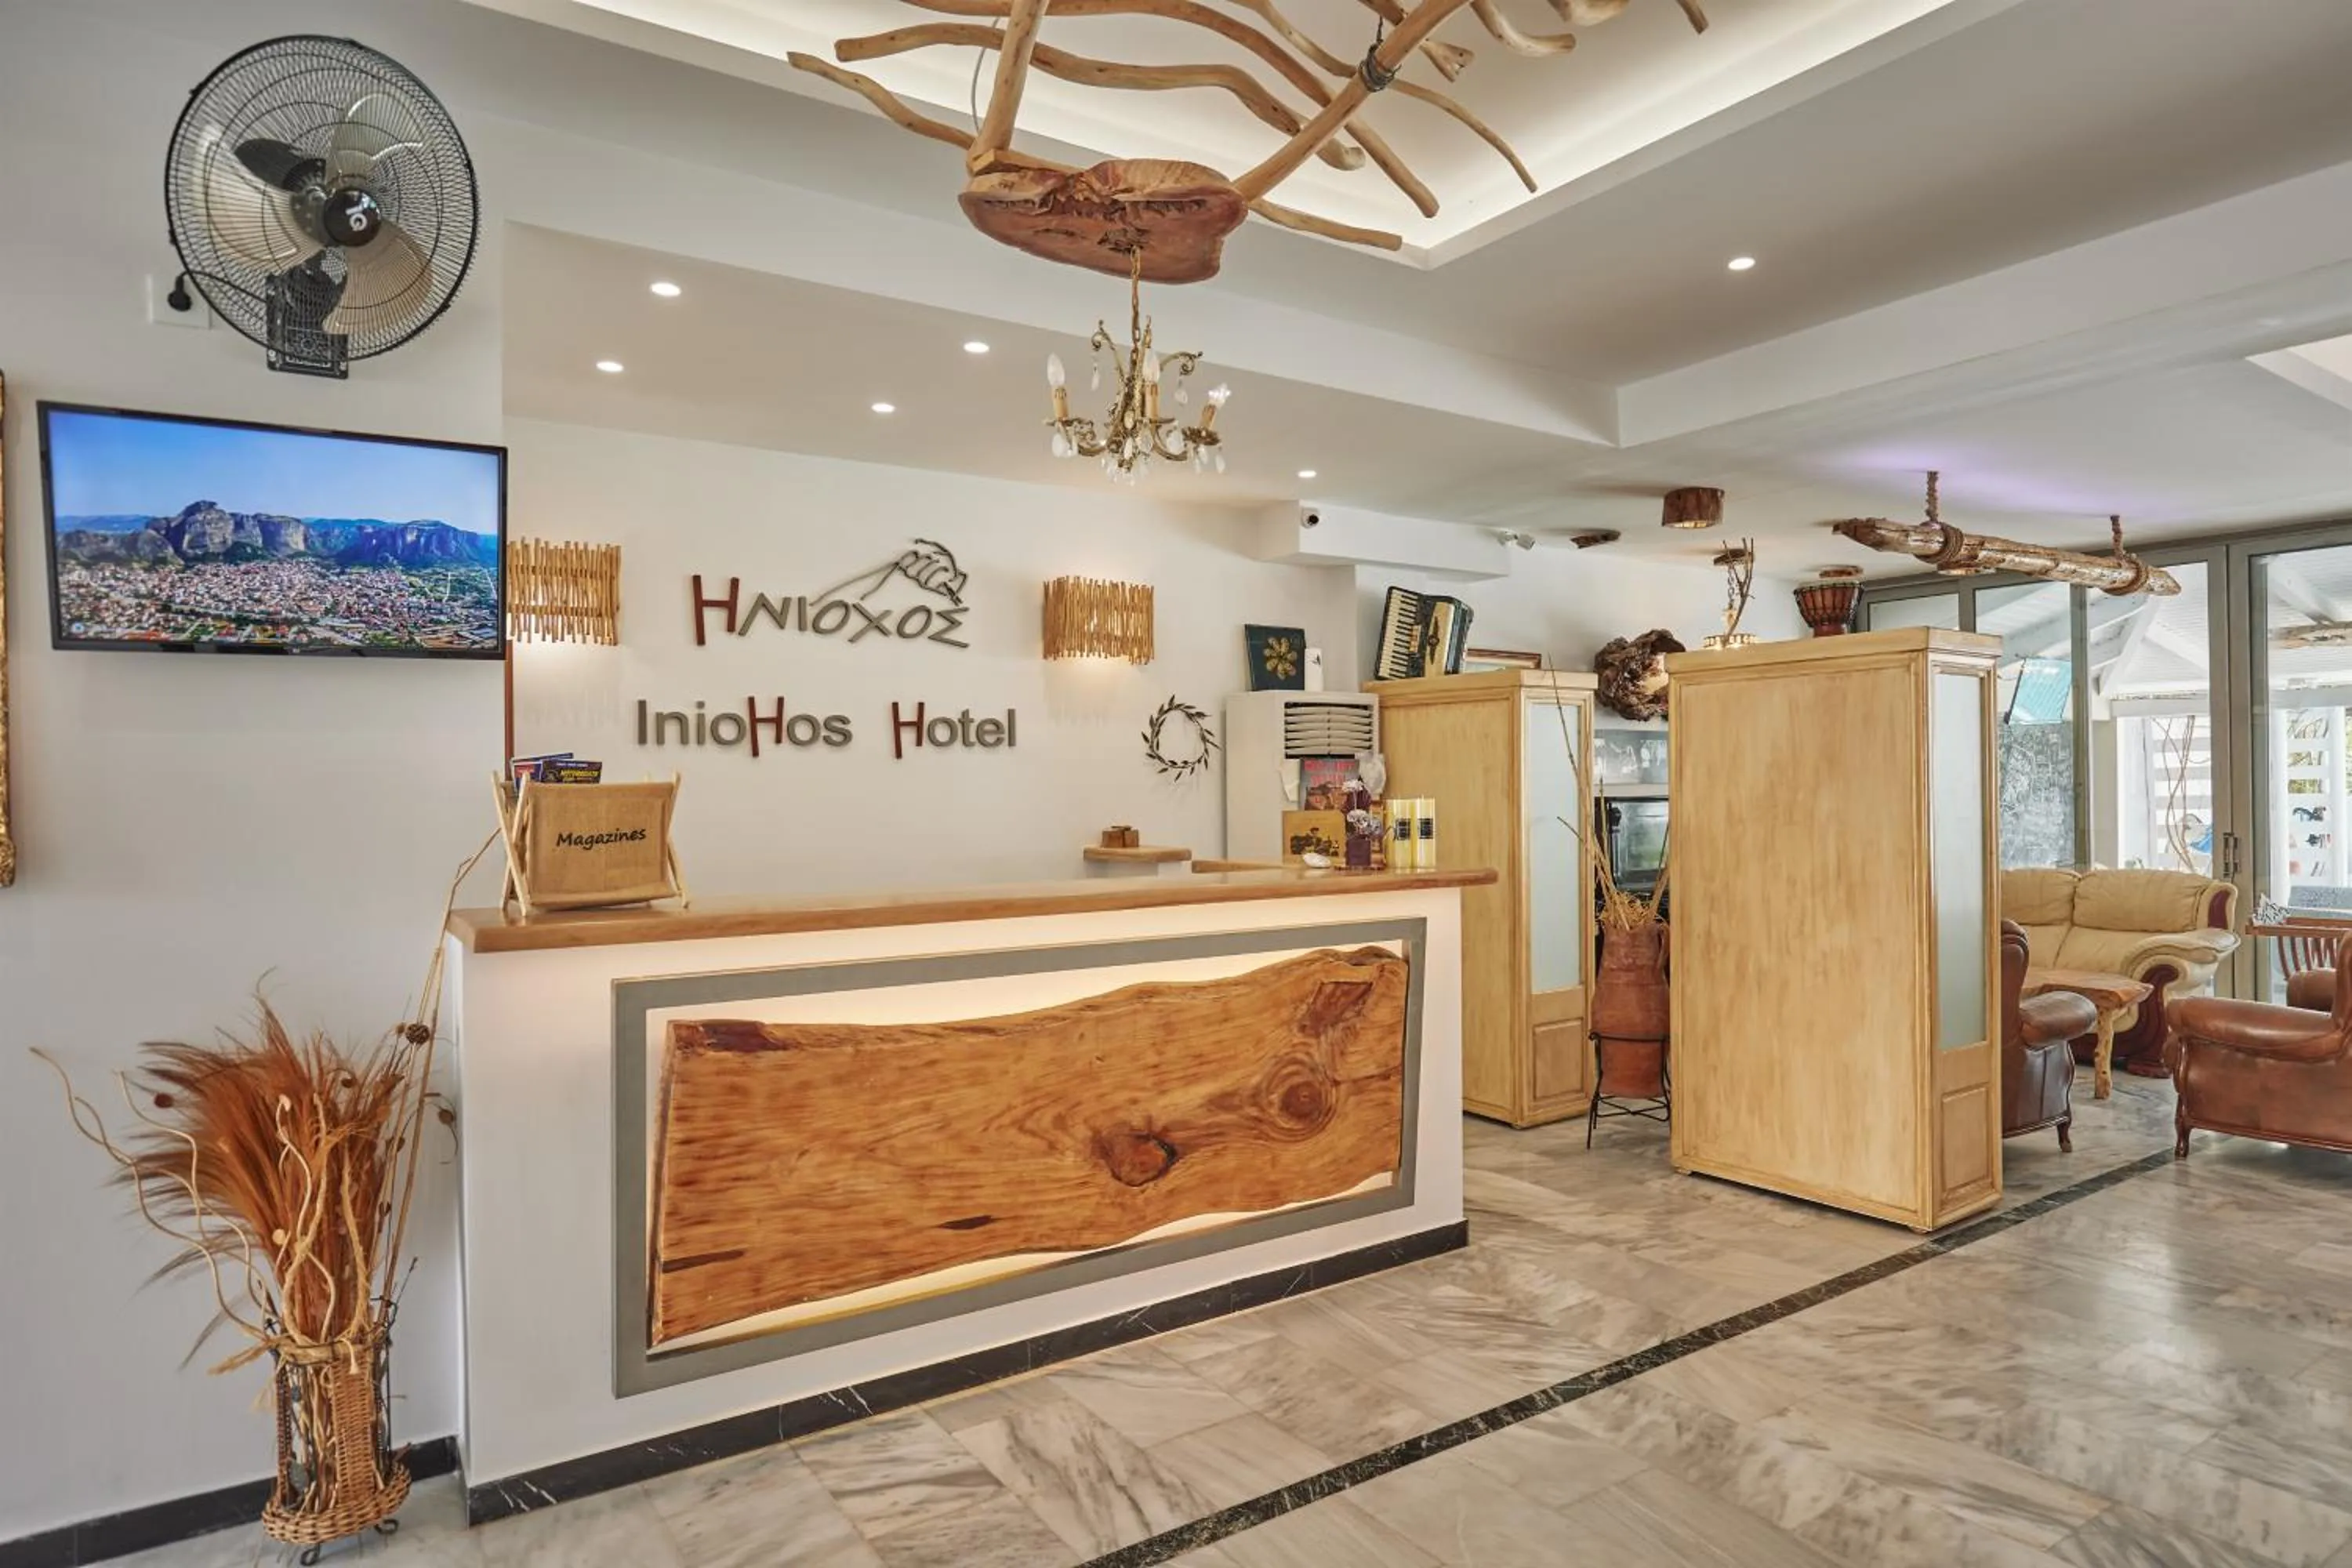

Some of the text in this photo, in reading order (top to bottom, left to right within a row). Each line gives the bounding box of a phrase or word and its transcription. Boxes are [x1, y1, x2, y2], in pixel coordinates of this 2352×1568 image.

[637, 695, 1017, 759] InioHos Hotel
[556, 828, 647, 851] Magazines
